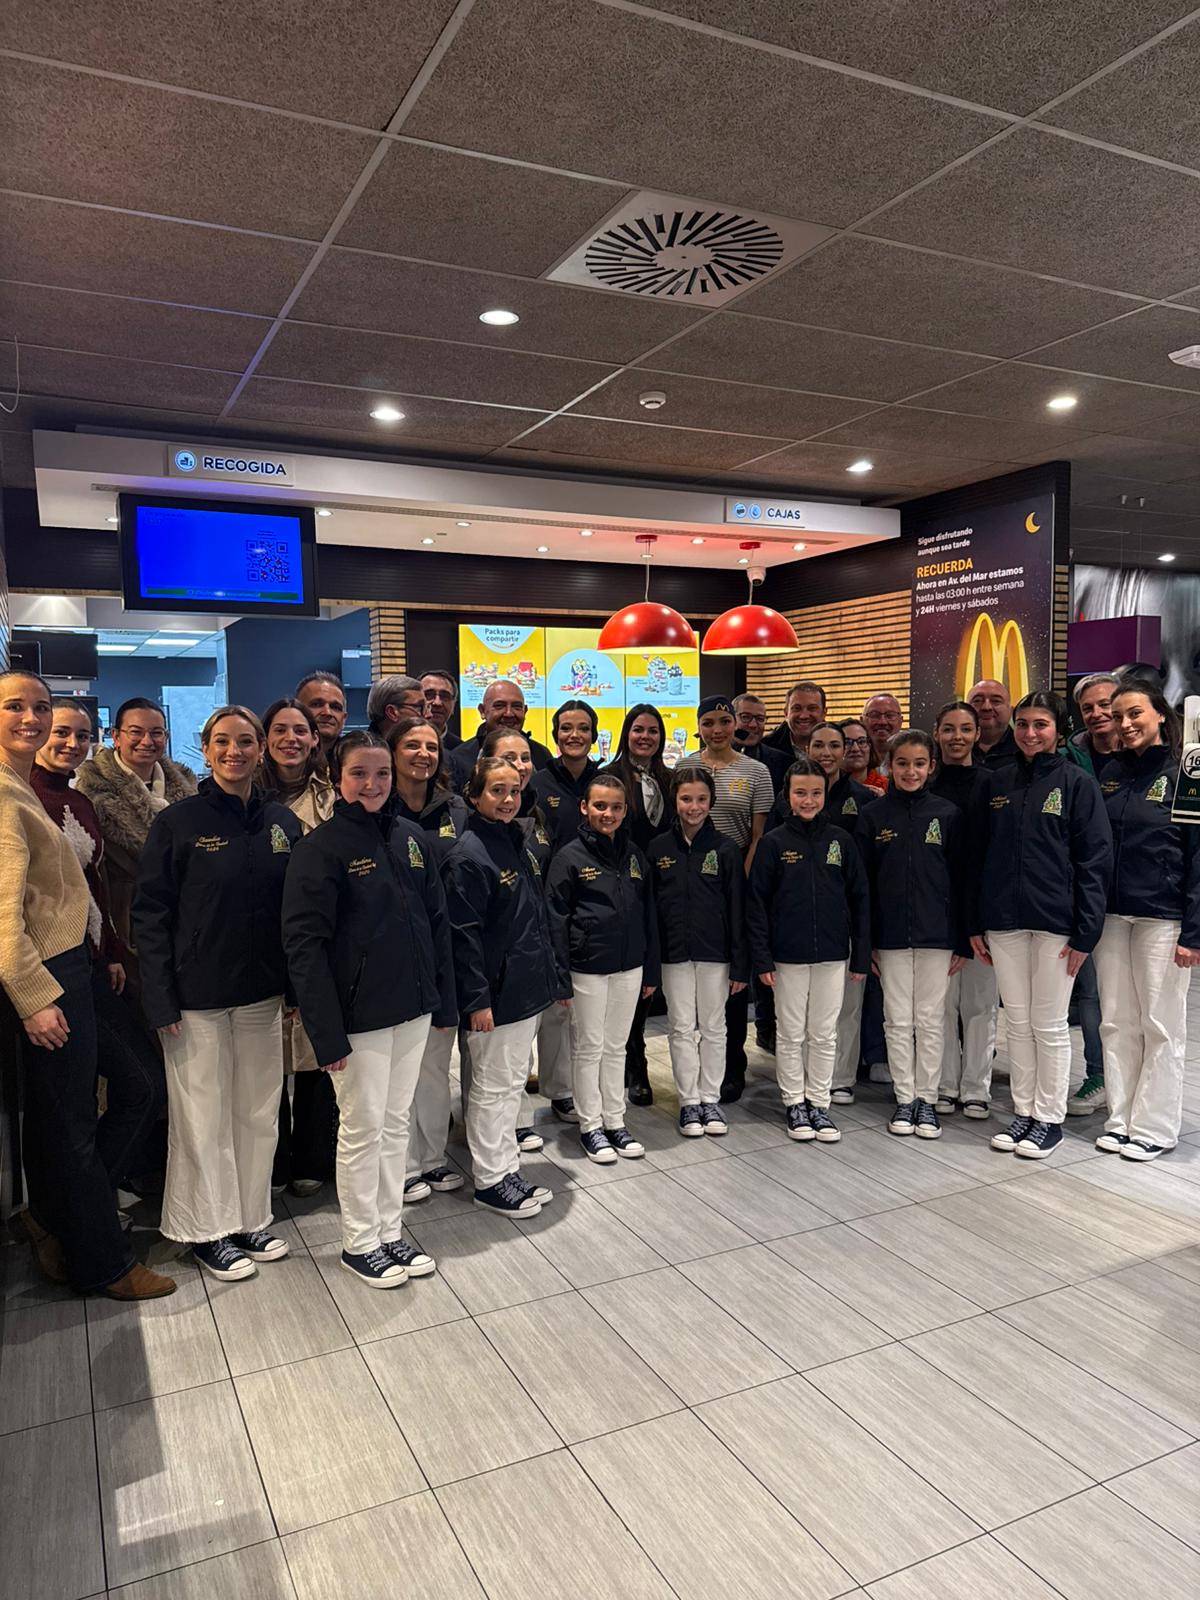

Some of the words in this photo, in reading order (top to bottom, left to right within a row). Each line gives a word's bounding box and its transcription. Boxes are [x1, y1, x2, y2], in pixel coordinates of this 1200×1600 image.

[203, 456, 287, 476] RECOGIDA
[767, 507, 801, 520] CAJAS
[918, 536, 935, 546] Sigue
[935, 527, 973, 542] disfrutando
[917, 546, 940, 556] aunque
[940, 543, 952, 551] sea
[952, 538, 970, 549] tarde
[916, 557, 973, 578] RECUERDA
[916, 581, 937, 591] Ahora
[937, 579, 947, 587] en
[959, 574, 971, 584] del
[972, 572, 988, 582] Mar
[988, 566, 1024, 579] estamos
[915, 593, 935, 604] hasta
[935, 591, 945, 600] las
[946, 588, 966, 599] 03:00
[966, 586, 972, 595] h
[972, 584, 992, 594] entre
[993, 580, 1025, 592] semana
[915, 608, 921, 618] y
[920, 605, 935, 615] 24H
[935, 602, 961, 613] viernes
[961, 602, 967, 612] y
[967, 596, 999, 609] sábados
[485, 627, 505, 635] Packs
[505, 629, 520, 637] para
[486, 635, 519, 643] compartir
